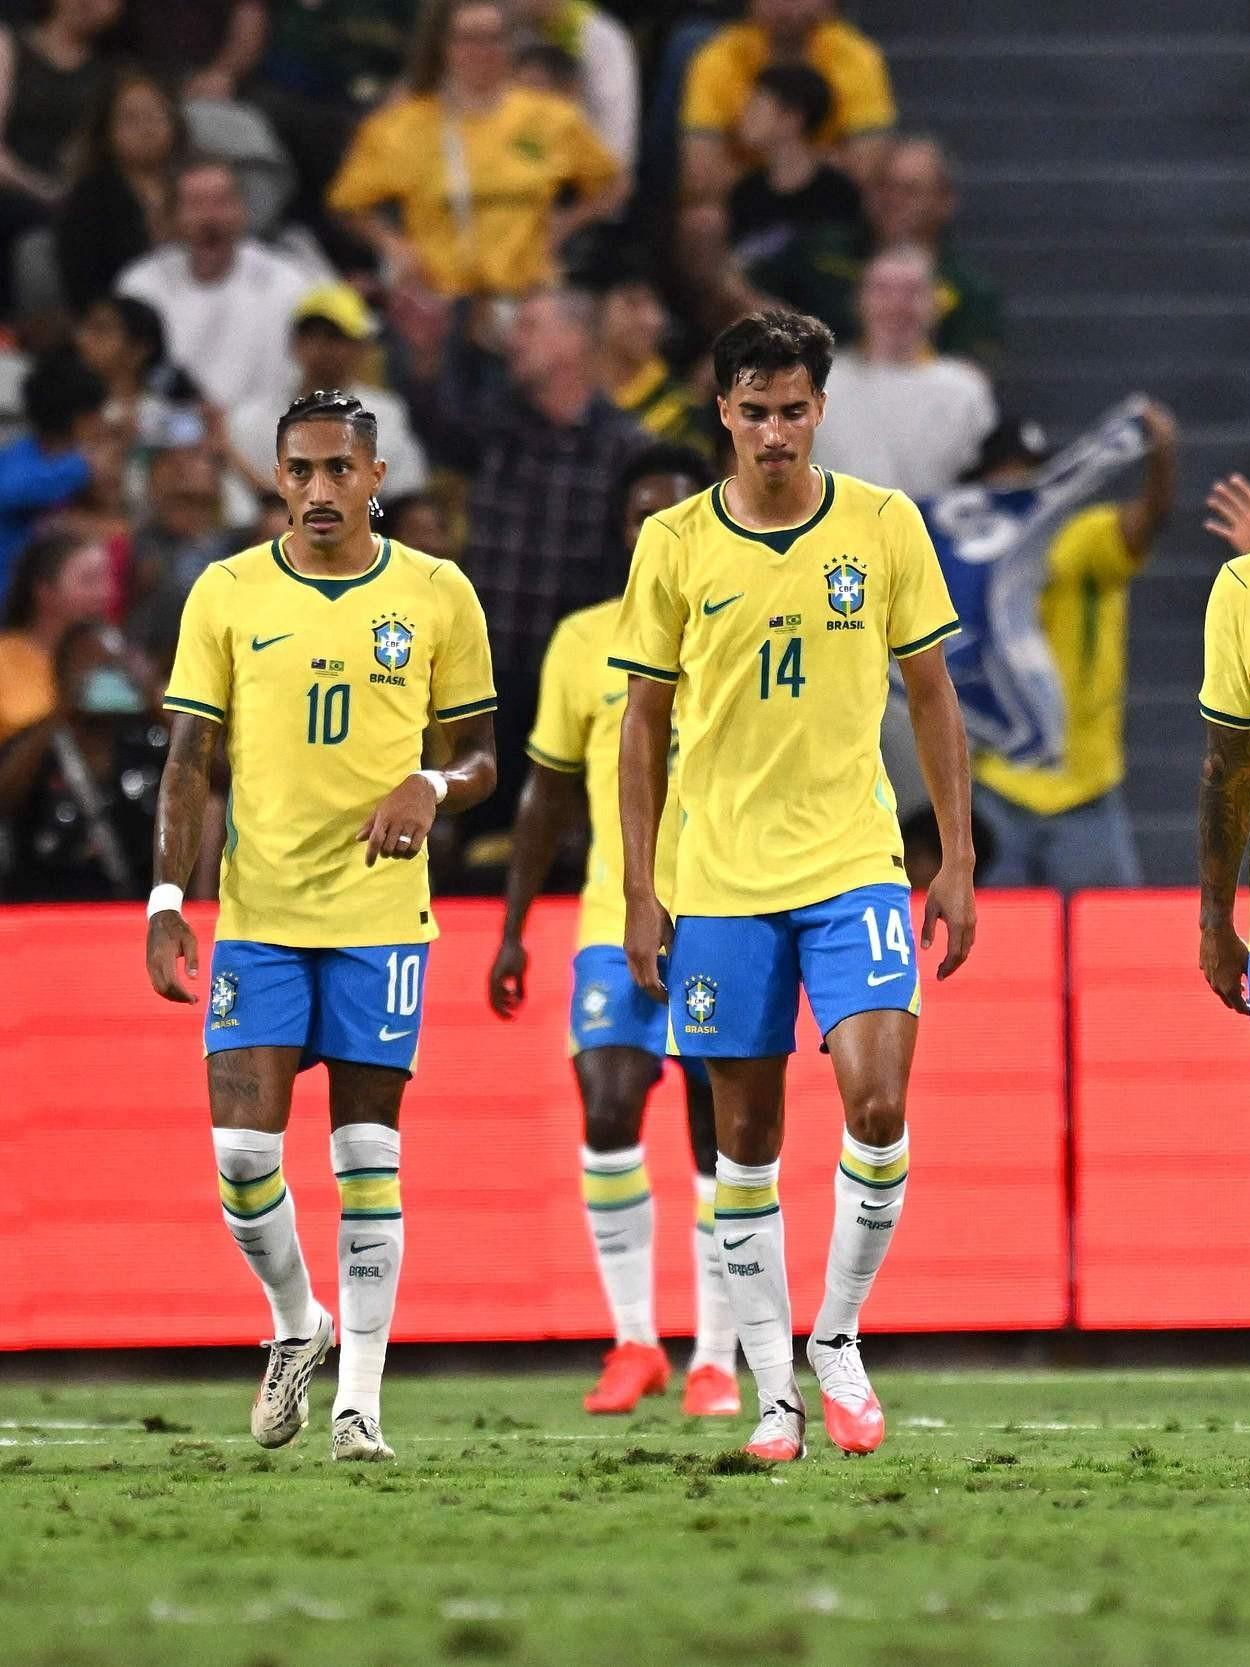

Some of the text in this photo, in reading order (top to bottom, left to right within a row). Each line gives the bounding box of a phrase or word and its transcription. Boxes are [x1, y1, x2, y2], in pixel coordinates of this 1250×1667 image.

[826, 620, 865, 631] BRASIL
[758, 637, 806, 700] 14
[369, 673, 407, 687] BRASIL
[307, 683, 351, 745] 10
[862, 906, 911, 965] 14
[386, 951, 421, 1016] 10
[685, 1025, 719, 1034] BRASIL
[856, 1216, 895, 1231] BRASIL
[349, 1265, 384, 1278] BRASIL
[728, 1262, 765, 1277] BRASIL
